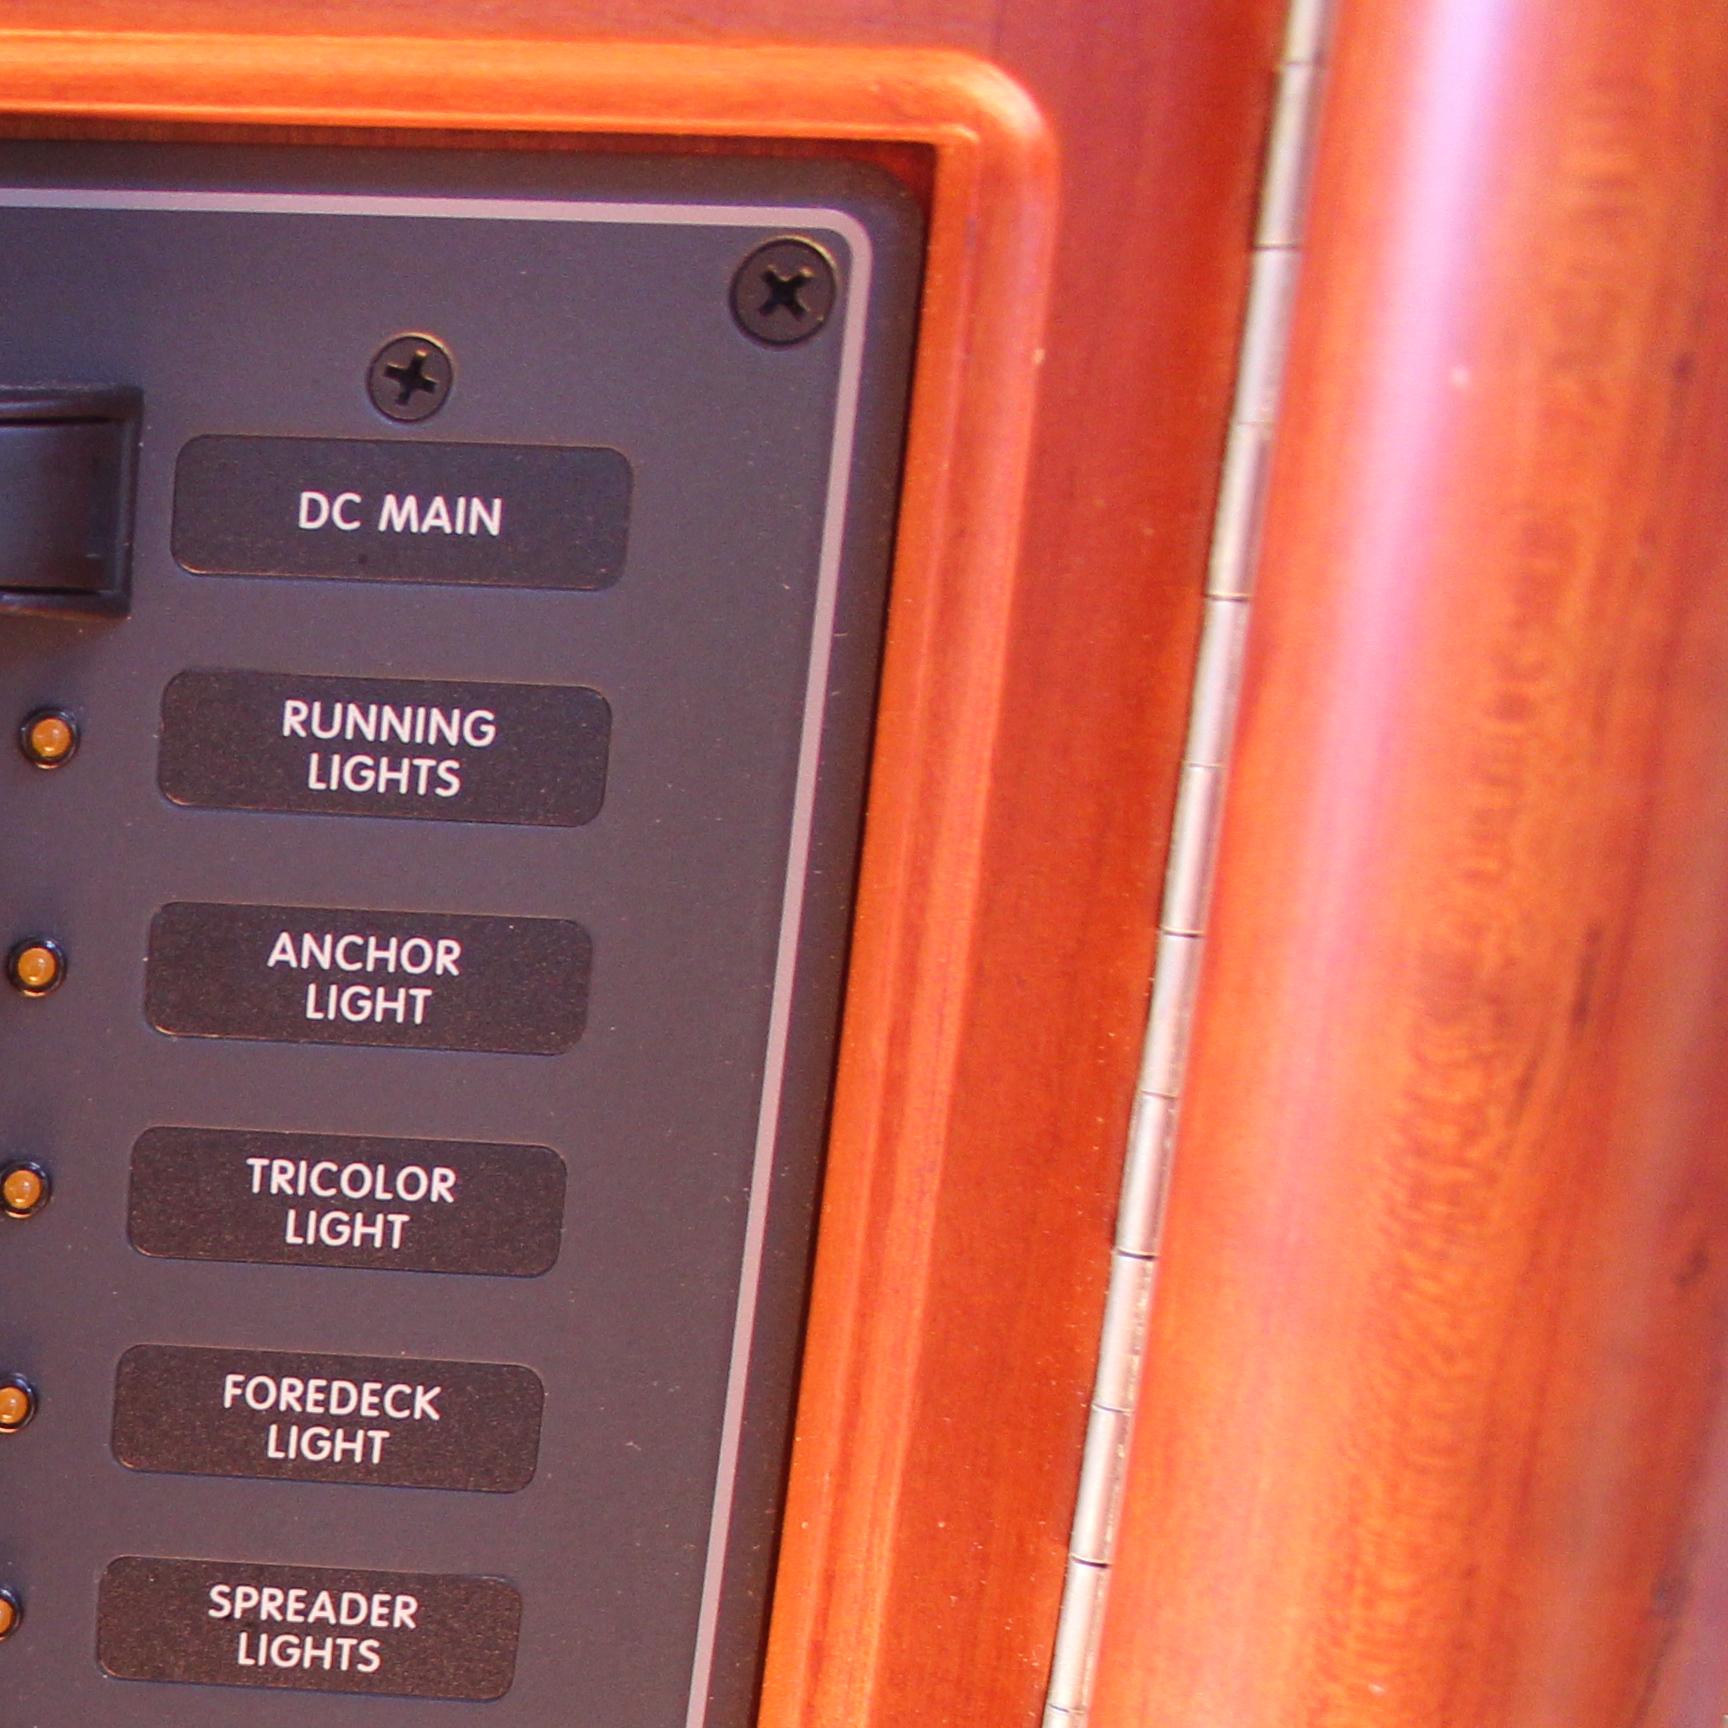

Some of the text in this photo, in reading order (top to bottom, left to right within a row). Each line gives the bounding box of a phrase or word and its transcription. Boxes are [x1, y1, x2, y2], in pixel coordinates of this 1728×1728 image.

[298, 491, 502, 536] DC MAIN
[282, 699, 496, 747] RUNNING
[308, 752, 460, 797] LIGHTS
[267, 931, 461, 976] ANCHOR
[306, 983, 433, 1025] LIGHT
[246, 1157, 456, 1203] TRICOLOR
[285, 1209, 410, 1249] LIGHT
[223, 1374, 441, 1421] FOREDECK
[267, 1424, 390, 1464] LIGHT
[208, 1584, 418, 1629] SPREADER
[237, 1632, 381, 1673] LIGHTS
